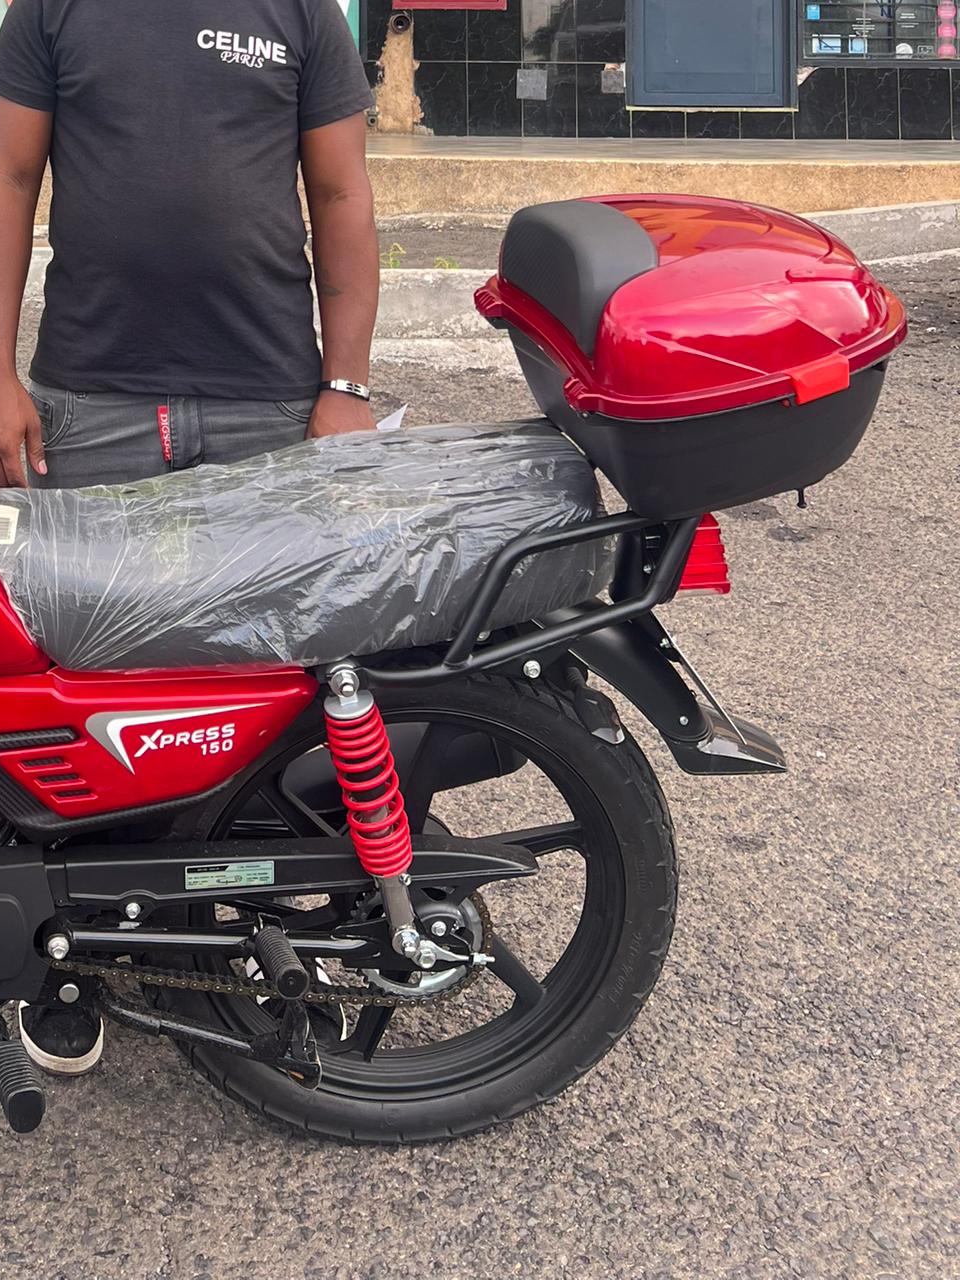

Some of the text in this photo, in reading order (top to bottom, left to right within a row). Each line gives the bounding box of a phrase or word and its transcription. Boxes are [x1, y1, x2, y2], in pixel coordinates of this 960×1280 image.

[197, 29, 287, 64] CELINE
[220, 51, 265, 68] PARIS
[134, 723, 236, 758] XPRESS
[200, 739, 234, 756] 150
